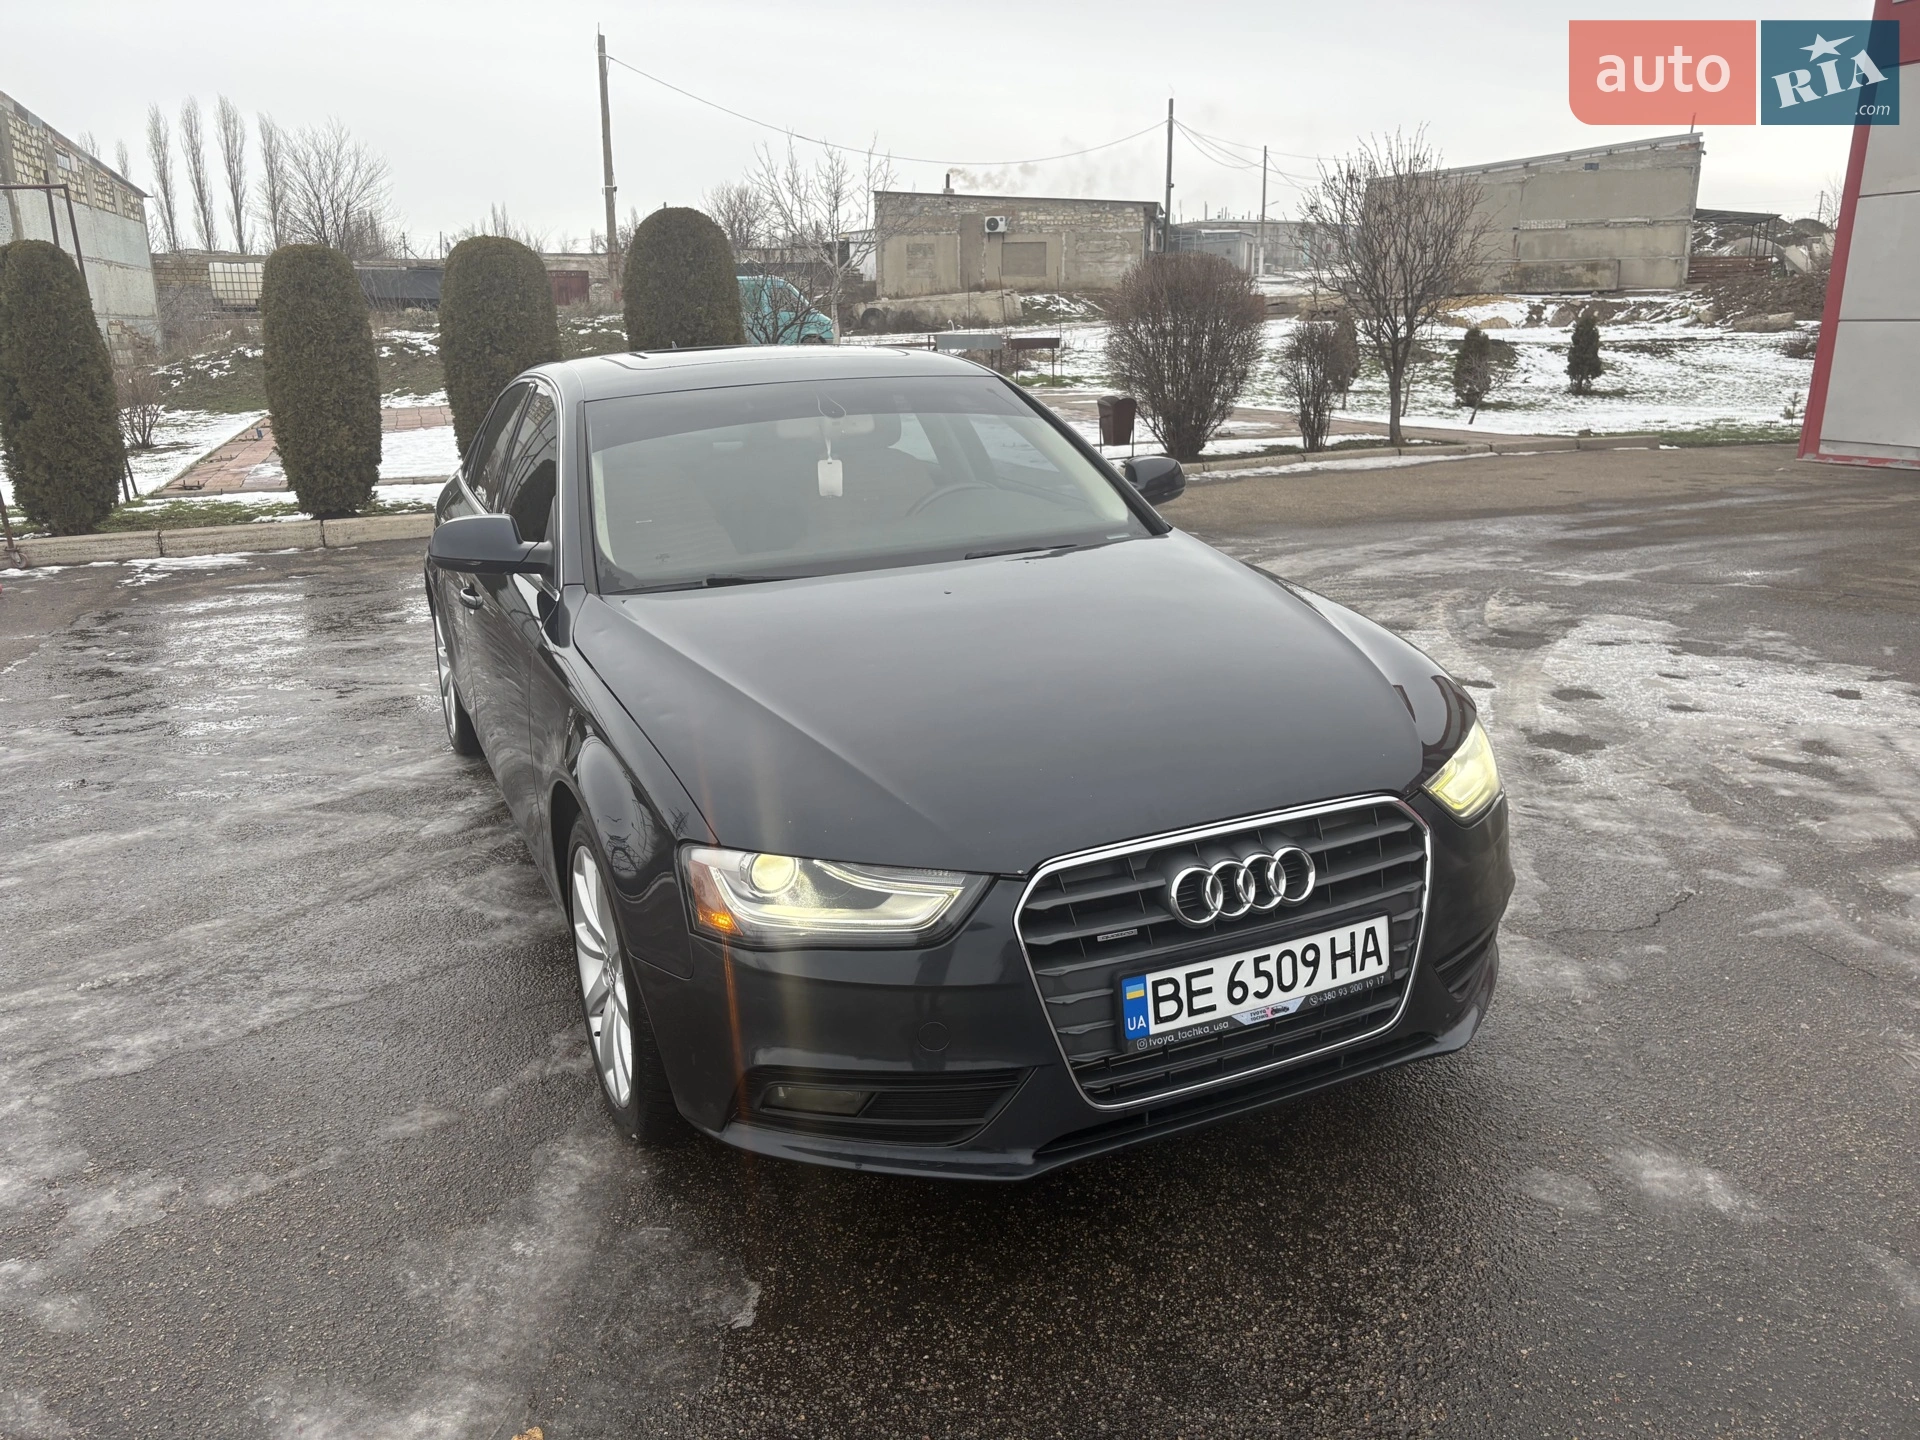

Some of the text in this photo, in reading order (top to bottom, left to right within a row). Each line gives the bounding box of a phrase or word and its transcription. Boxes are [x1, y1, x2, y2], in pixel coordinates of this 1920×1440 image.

[1151, 926, 1383, 1026] BE 6509 HA
[1338, 987, 1348, 997] 93
[1350, 982, 1363, 994] 200
[1365, 979, 1374, 989] 19
[1376, 975, 1385, 985] 17
[1127, 1015, 1147, 1031] UA
